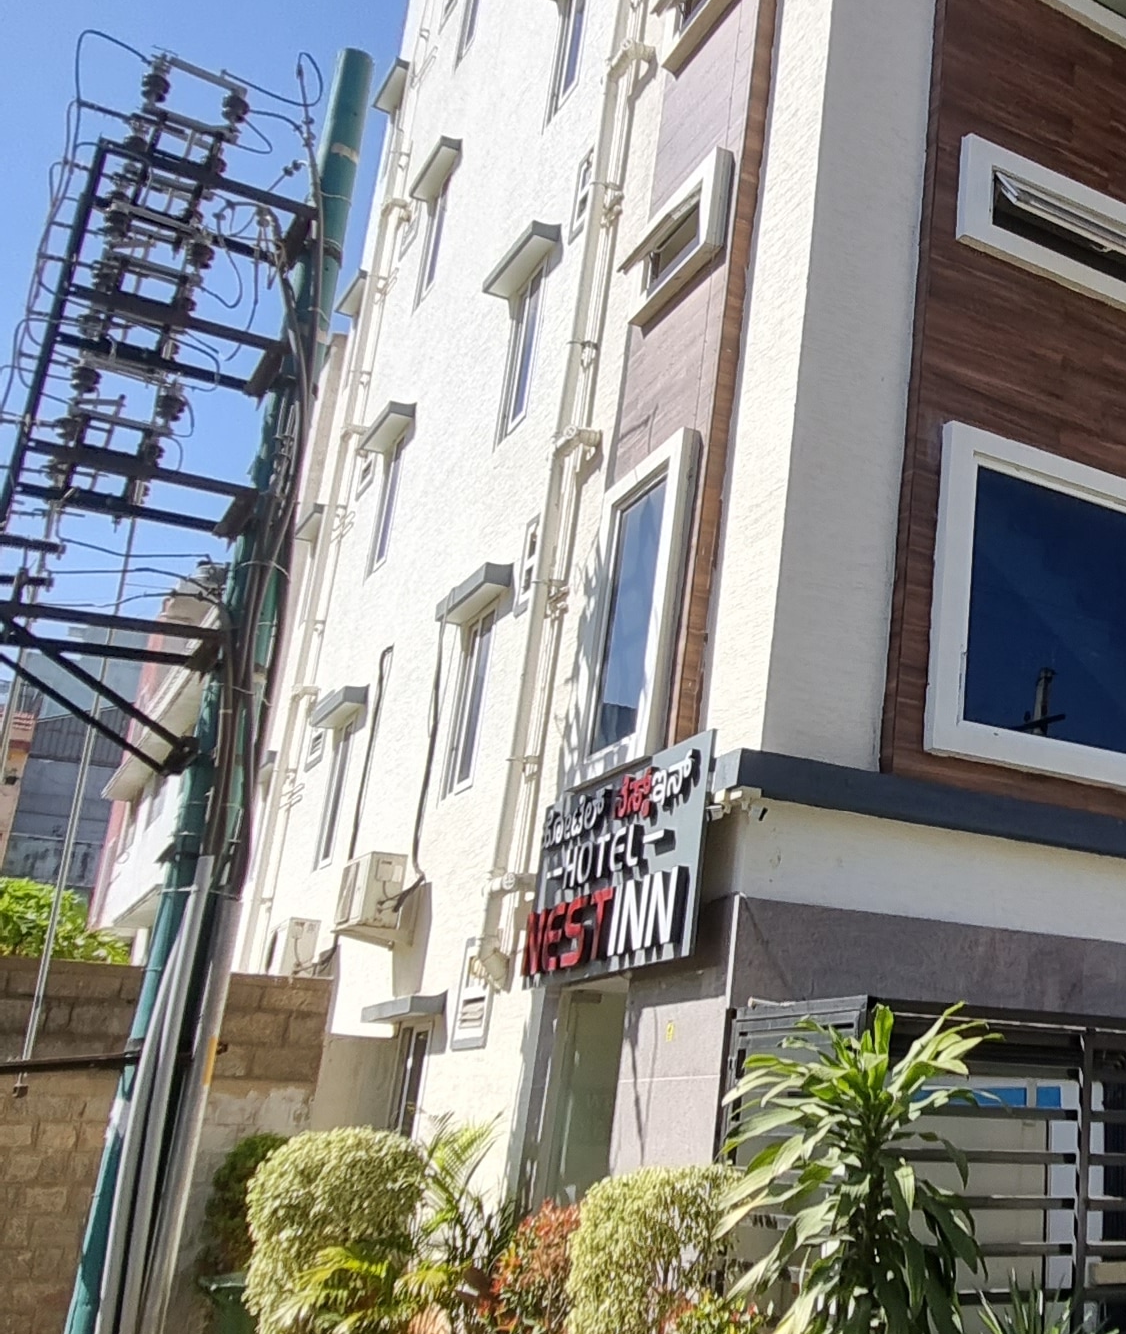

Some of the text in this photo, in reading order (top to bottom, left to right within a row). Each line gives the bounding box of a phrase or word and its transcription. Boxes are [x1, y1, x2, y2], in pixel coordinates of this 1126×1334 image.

[562, 824, 638, 889] HOTEL
[523, 866, 680, 977] NEST INN
